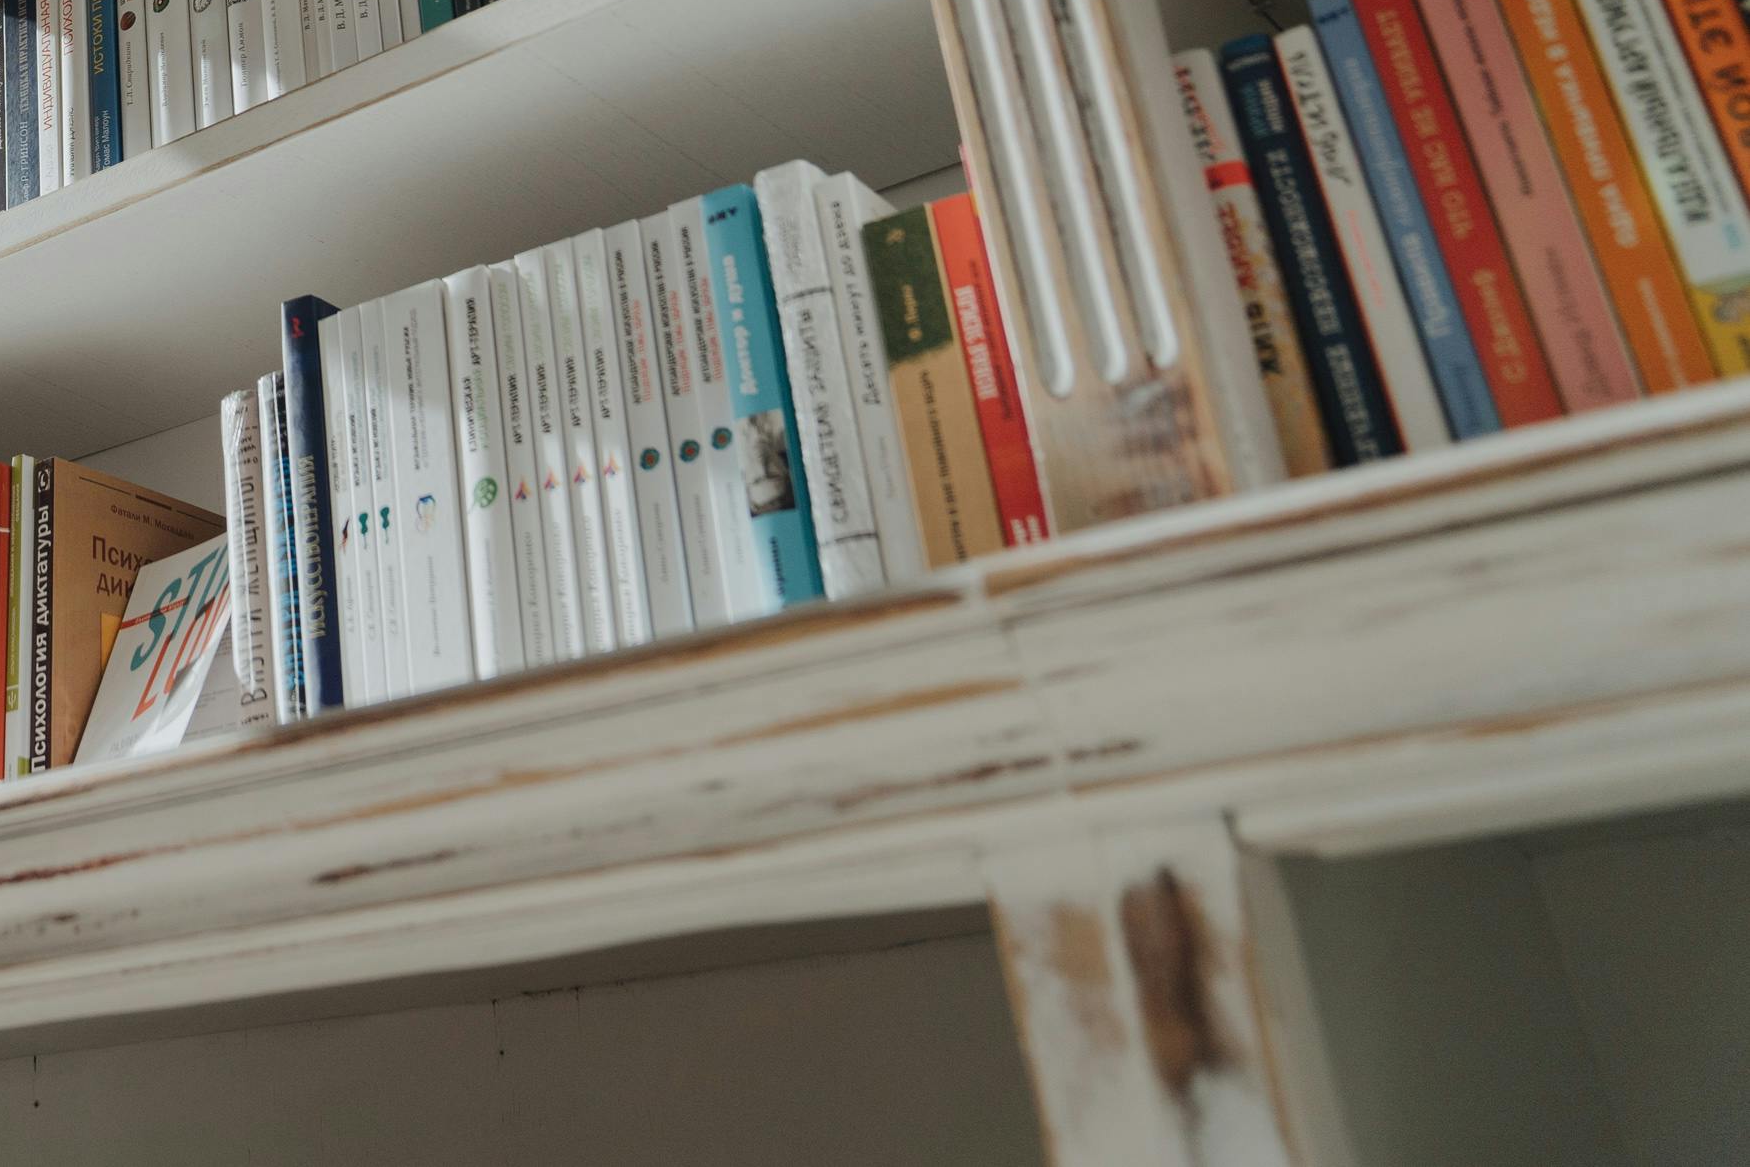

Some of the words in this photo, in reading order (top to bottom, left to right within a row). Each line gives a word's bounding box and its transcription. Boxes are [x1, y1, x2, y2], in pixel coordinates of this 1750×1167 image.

[334, 7, 346, 19] Д.
[335, 19, 347, 30] В.
[358, 8, 369, 18] В.
[91, 13, 105, 74] ИСТОКИ
[100, 109, 111, 142] Малоун
[101, 142, 111, 168] Томас
[720, 253, 743, 305] душа
[728, 307, 746, 322] и
[731, 324, 759, 396] Доктор
[34, 505, 52, 625] диктатуры
[296, 454, 326, 638] ИСКУССТВОТЕРАПИЯ
[30, 631, 49, 772] Психология
